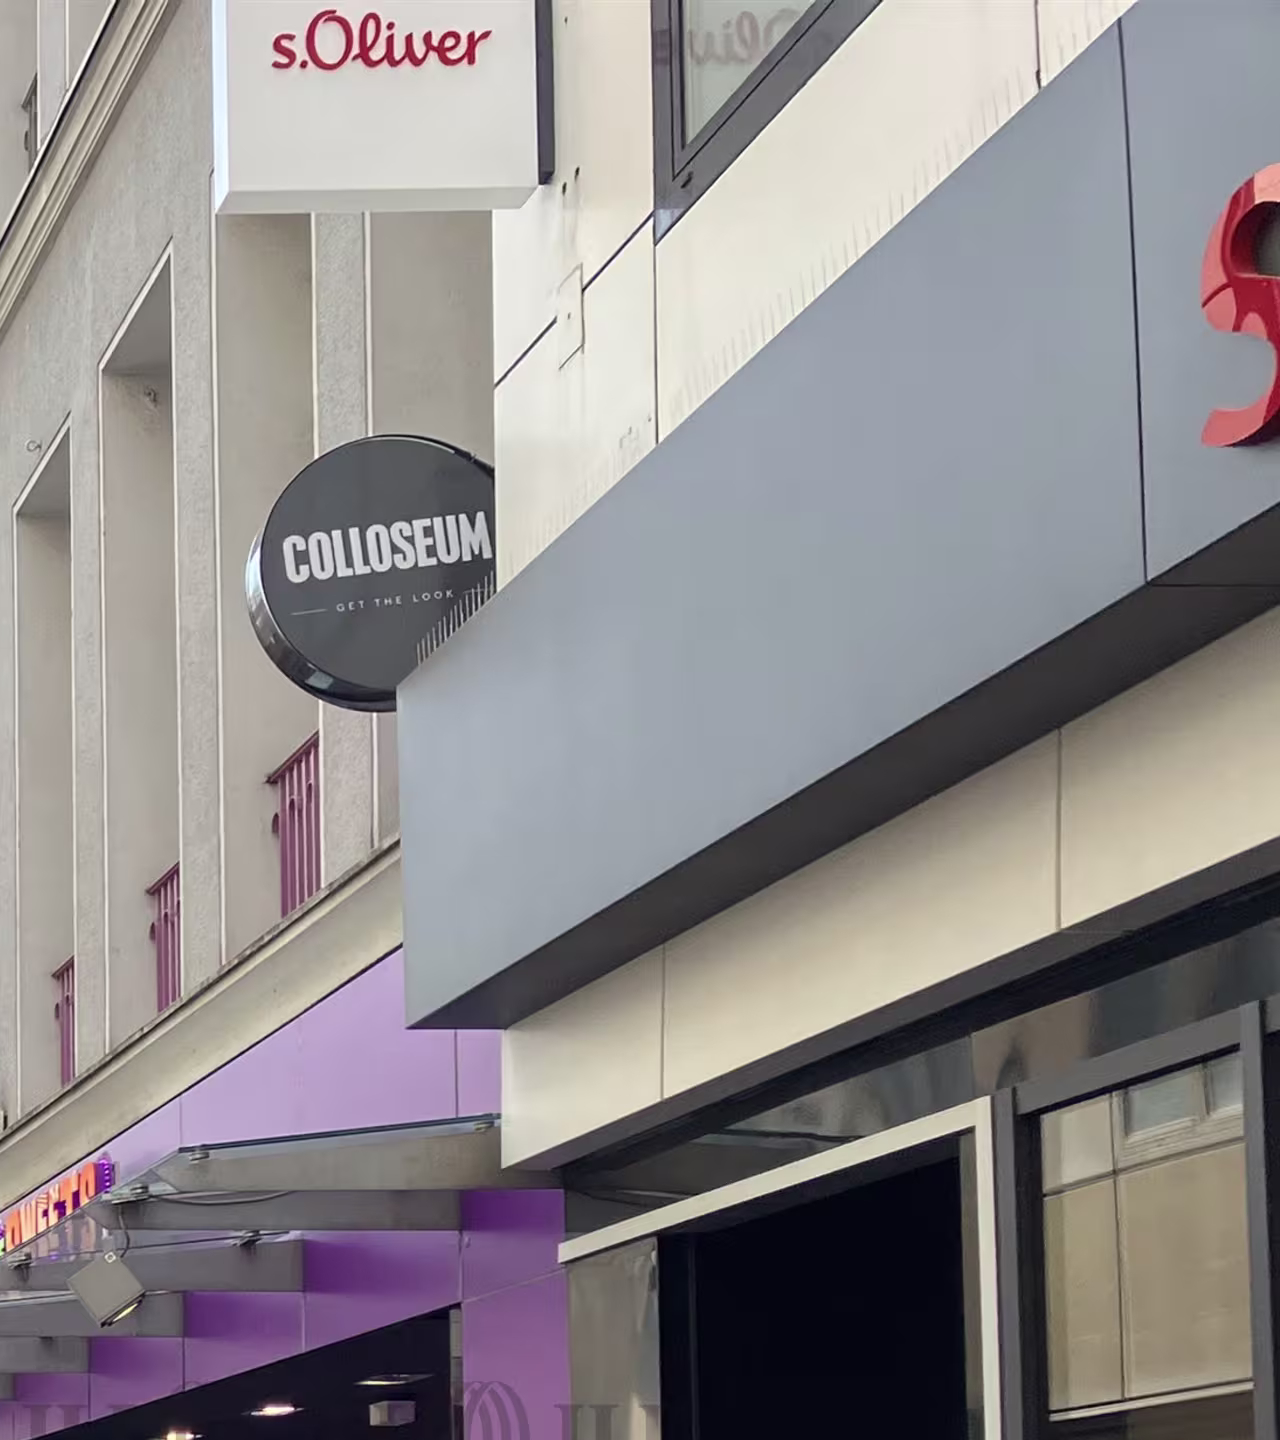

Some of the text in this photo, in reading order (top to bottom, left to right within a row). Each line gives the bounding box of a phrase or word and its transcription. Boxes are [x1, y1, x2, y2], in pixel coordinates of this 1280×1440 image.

[271, 9, 492, 72] s.Oliver
[282, 511, 493, 584] COLLOSEUM
[336, 588, 455, 613] GET THE LOOK
